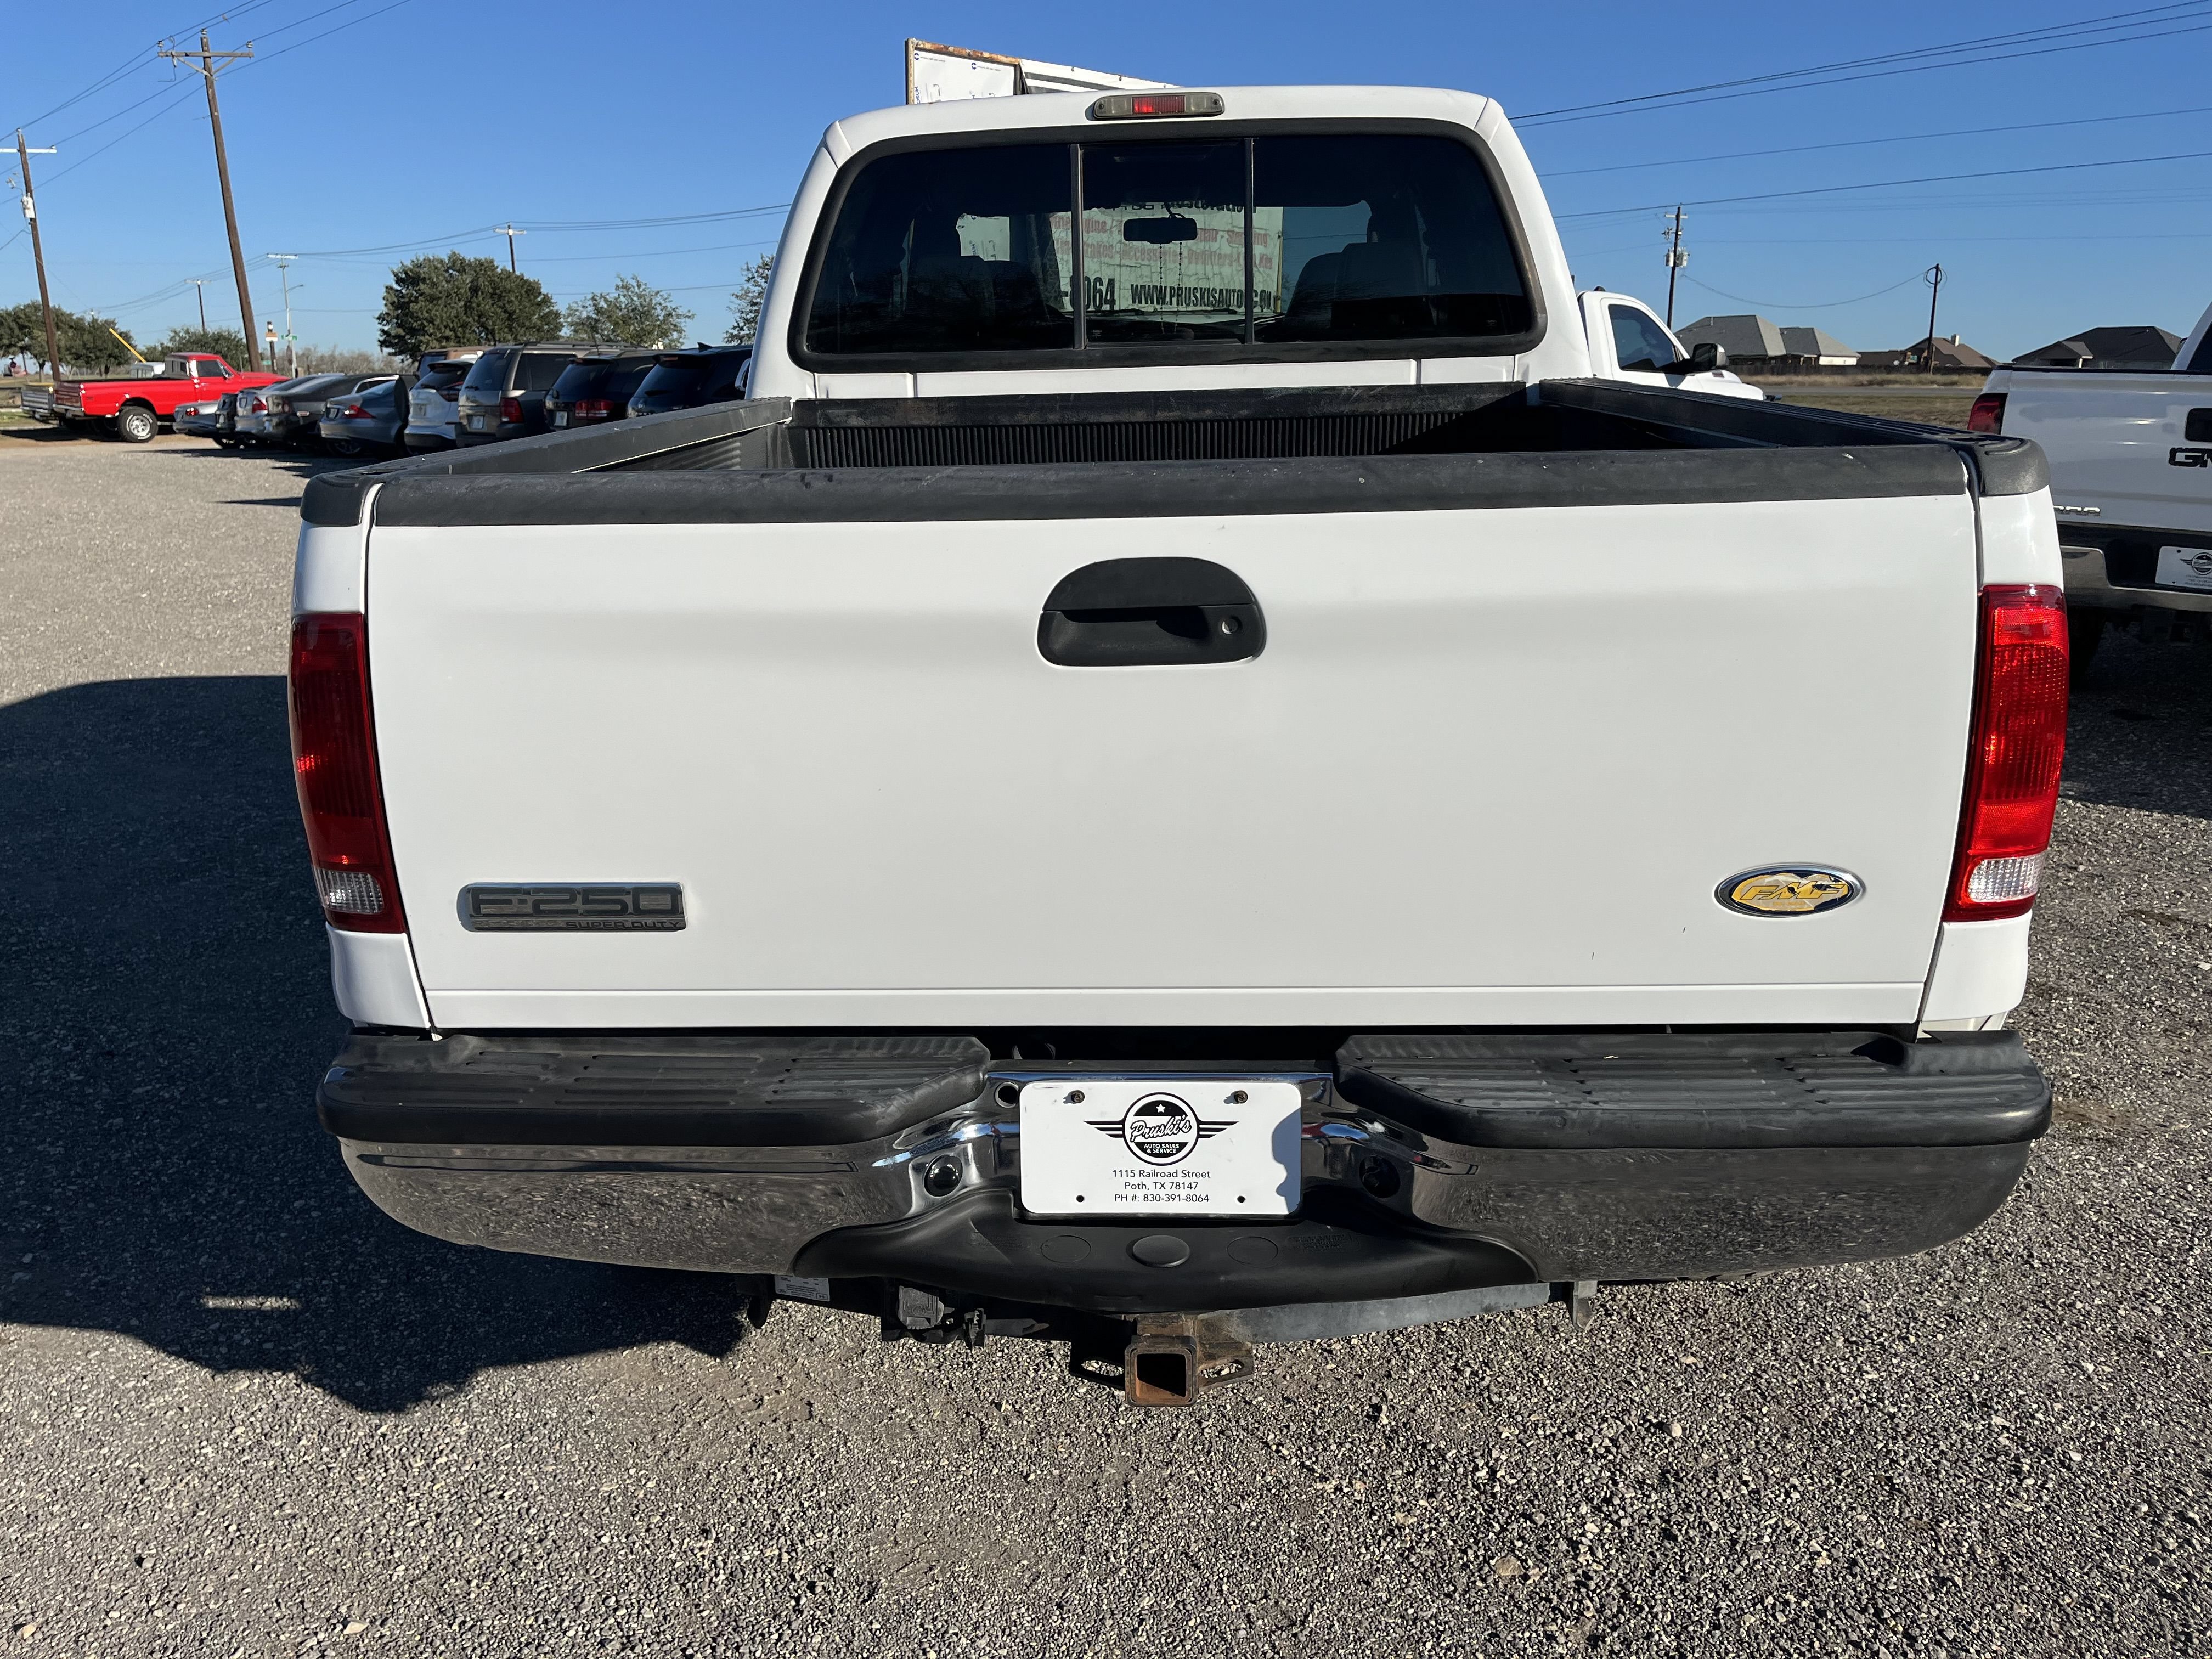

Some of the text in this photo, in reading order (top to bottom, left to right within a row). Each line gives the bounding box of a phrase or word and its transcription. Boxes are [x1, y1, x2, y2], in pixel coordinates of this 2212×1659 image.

[566, 920, 685, 930] SUPER DUTY
[1130, 1114, 1192, 1142] Pruski's
[1112, 1169, 1211, 1178] 1115 Railroad Street
[1125, 1181, 1198, 1191] Poth, TX 78147
[1114, 1194, 1210, 1203] PH #: 830-391-8064
